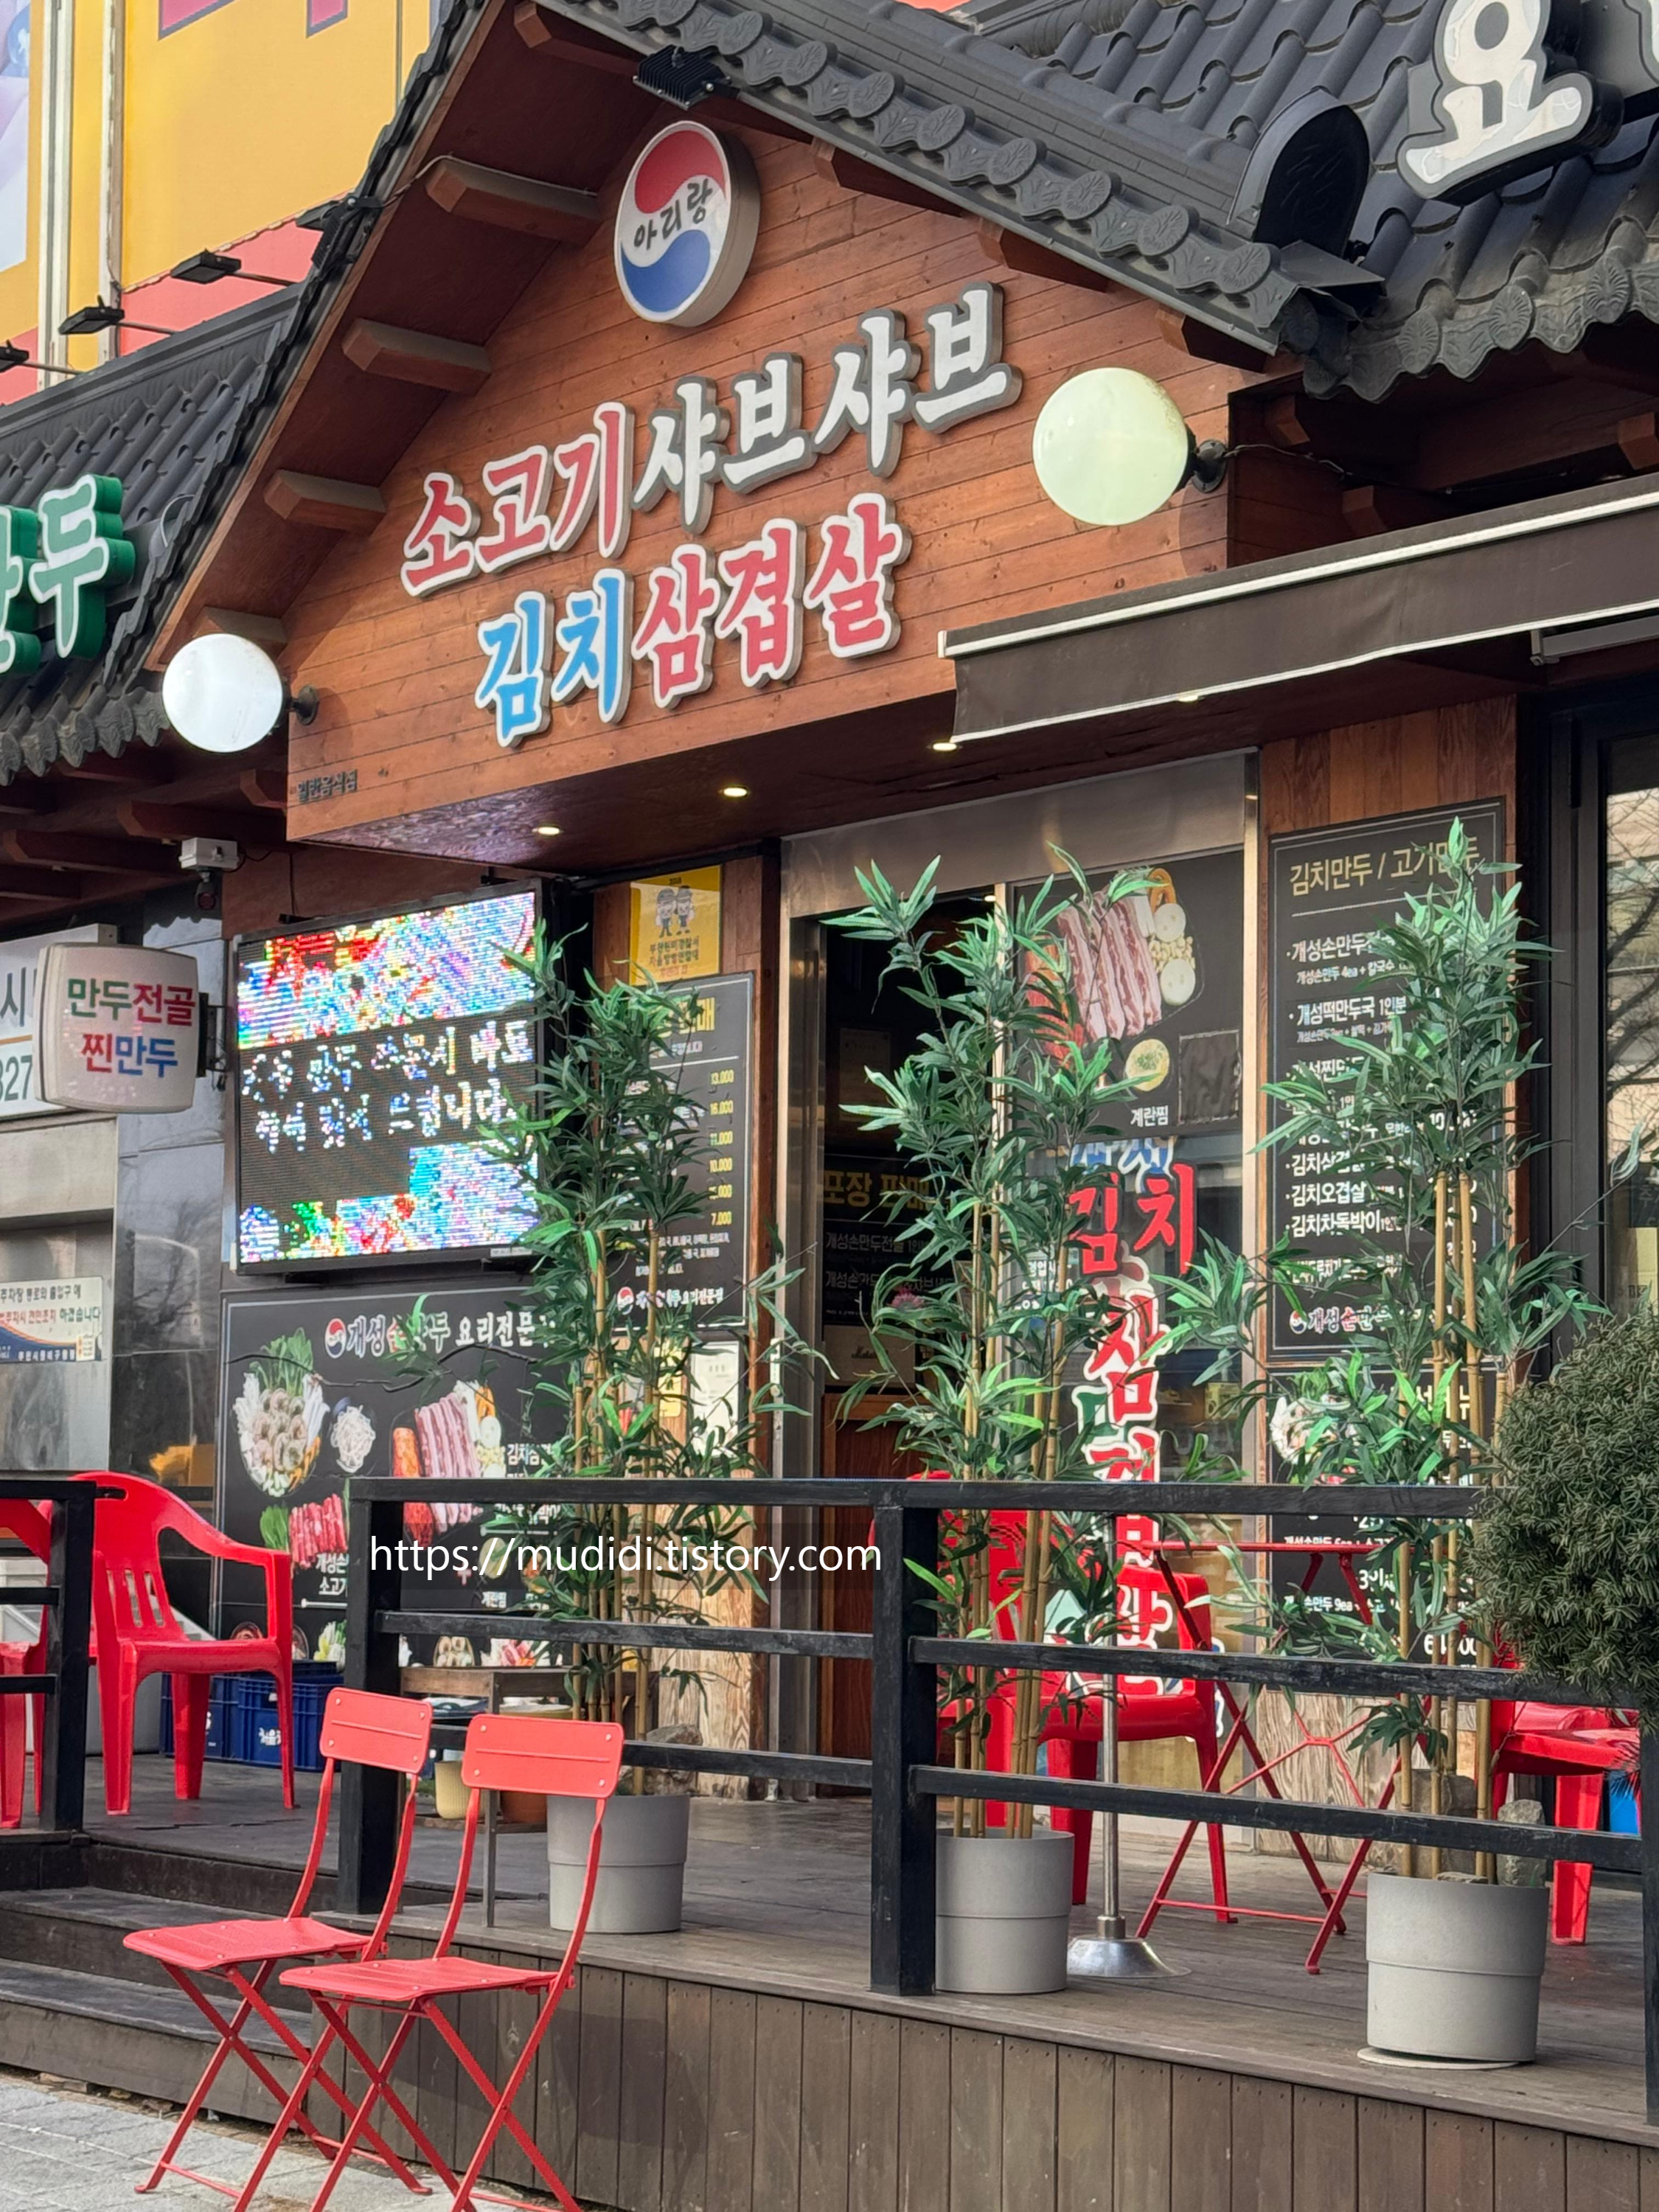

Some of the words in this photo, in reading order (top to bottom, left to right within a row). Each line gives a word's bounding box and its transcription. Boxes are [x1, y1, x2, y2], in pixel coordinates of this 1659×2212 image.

[633, 181, 713, 251] 아리랑
[1290, 852, 1373, 897] 김치만두
[1291, 930, 1397, 963] 개성손만두전
[1296, 996, 1375, 1026] 개성떡만두국
[1379, 995, 1407, 1016] 1인분
[81, 1033, 178, 1078] 찐만두
[0, 1055, 32, 1102] 27
[1130, 1105, 1169, 1127] 계란찜
[1291, 1180, 1366, 1207] 김치오겹살
[1069, 1163, 1194, 1275] 김치
[456, 1310, 555, 1349] 요리전문
[316, 1553, 349, 1574] 개성손
